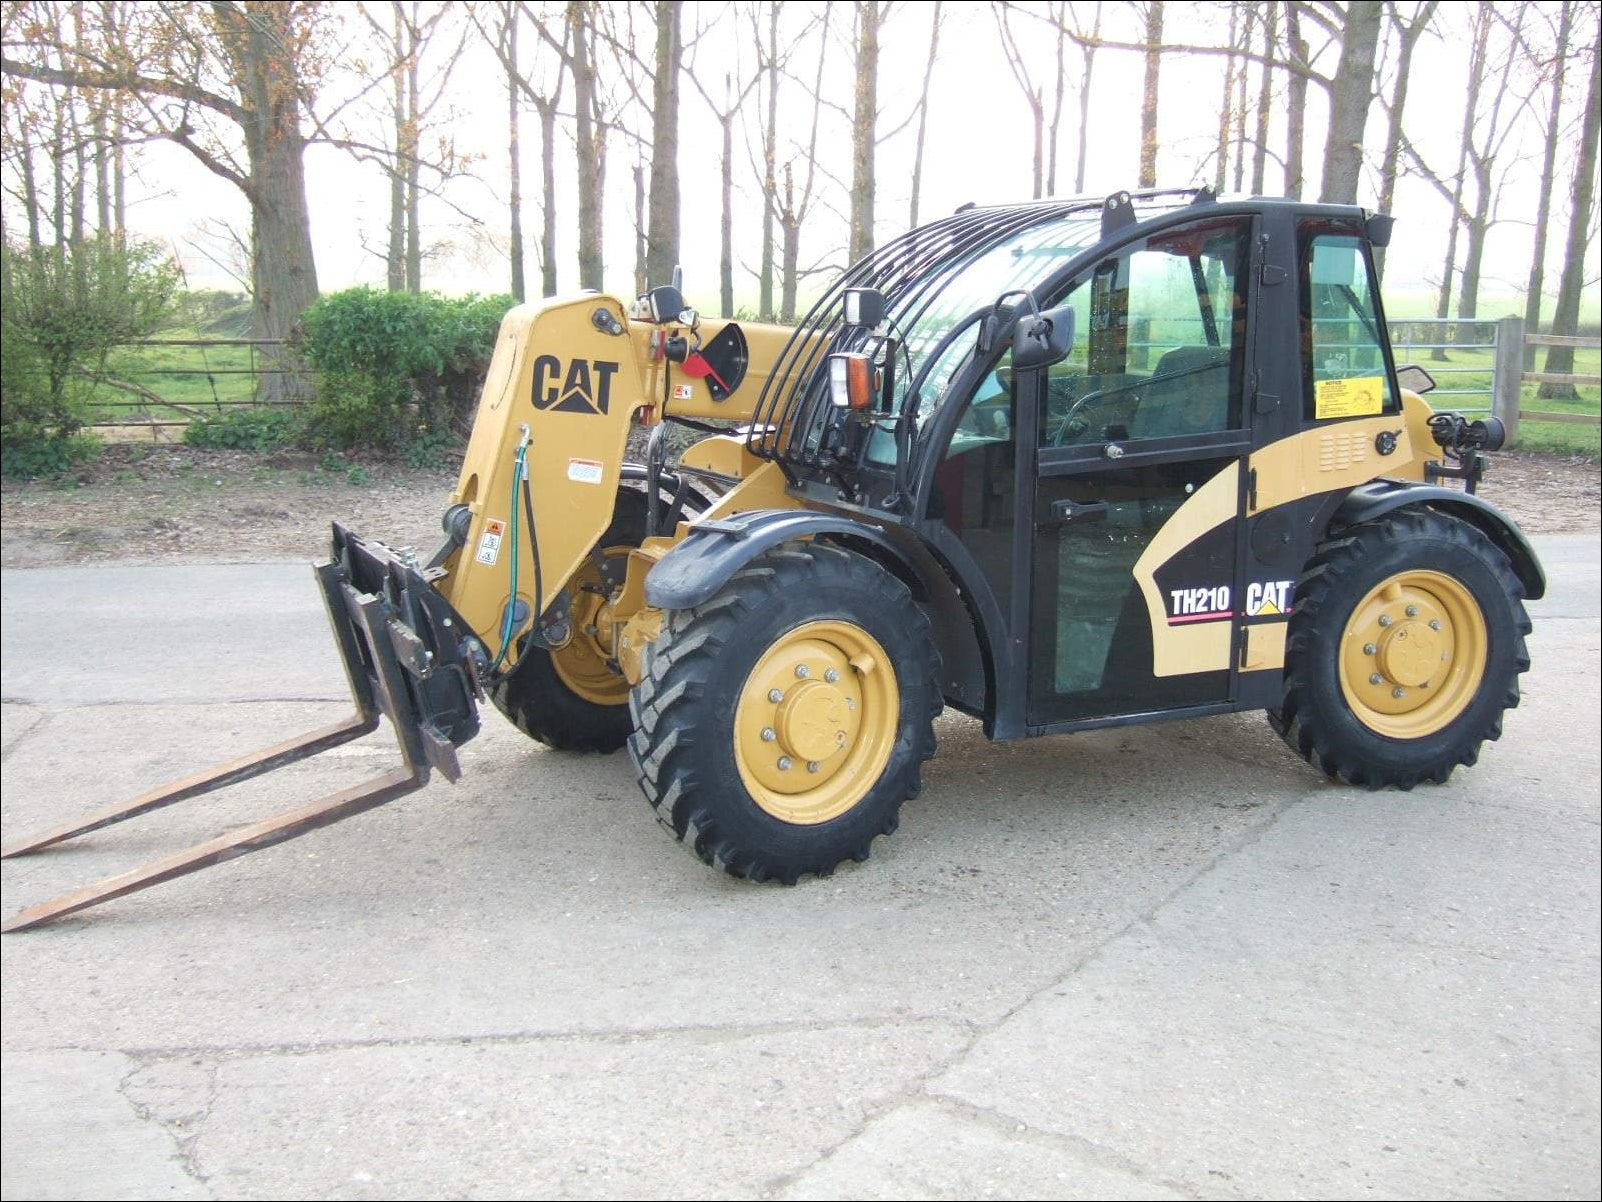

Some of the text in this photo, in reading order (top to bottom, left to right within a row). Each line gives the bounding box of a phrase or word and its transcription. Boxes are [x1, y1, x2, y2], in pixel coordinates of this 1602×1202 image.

[531, 354, 619, 416] CAT
[1170, 580, 1291, 616] TH210 CAT
